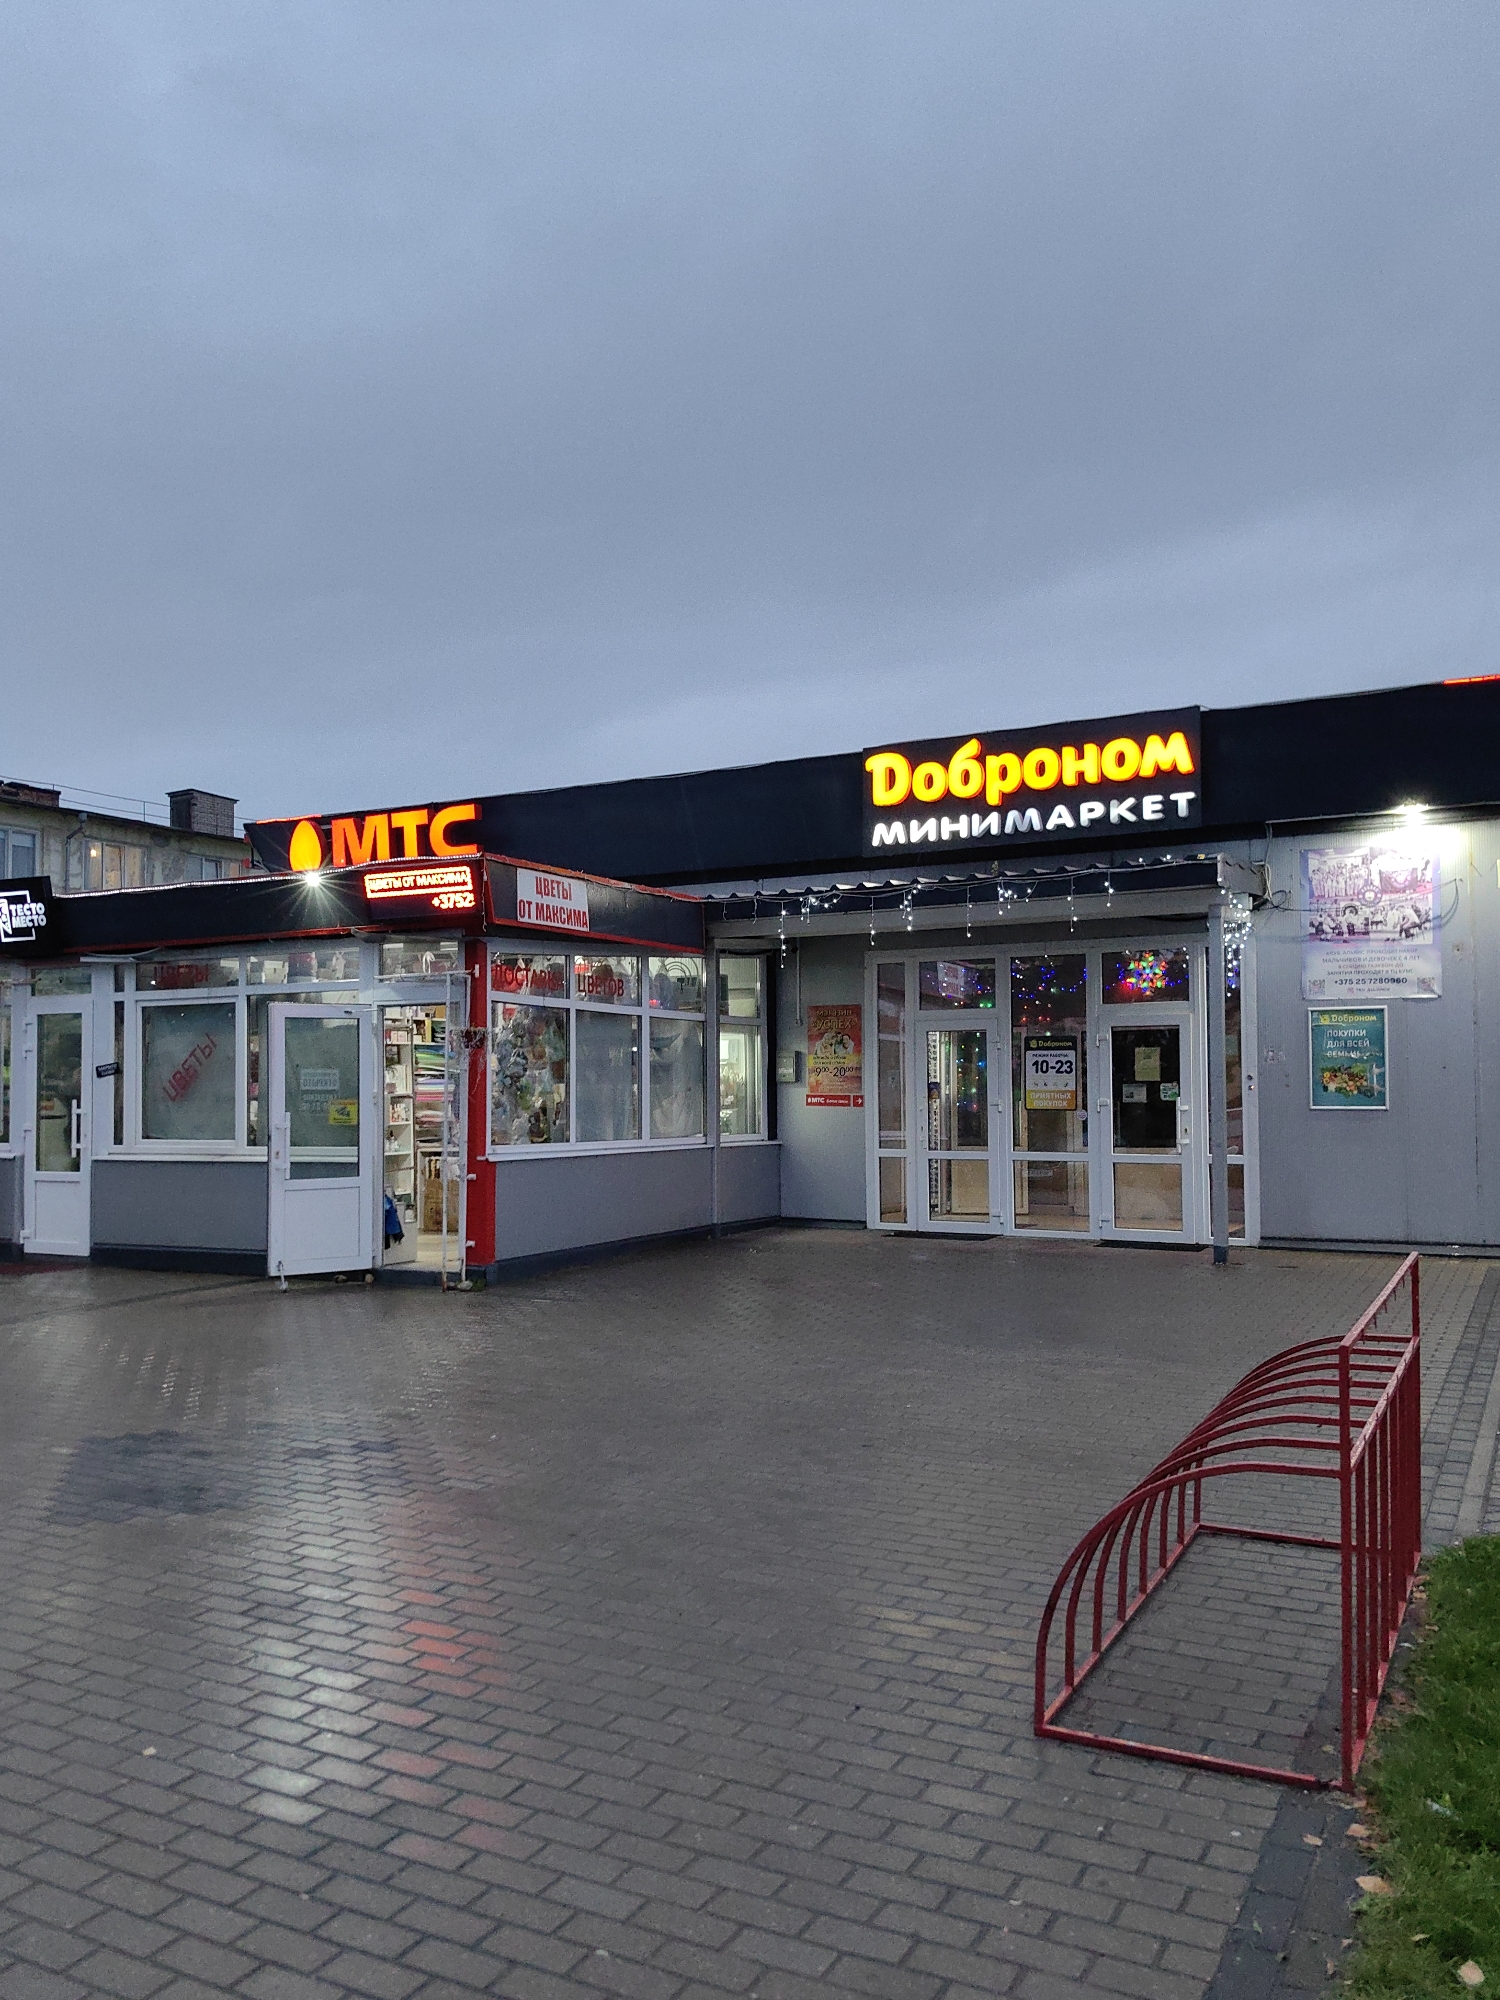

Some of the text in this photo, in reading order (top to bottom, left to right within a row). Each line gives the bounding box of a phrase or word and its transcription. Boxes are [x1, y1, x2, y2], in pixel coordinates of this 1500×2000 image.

[865, 732, 1195, 806] Доброном
[872, 792, 1196, 847] МИНИМАРКЕТ
[331, 804, 478, 867] МТС
[369, 872, 468, 891] ЦВЕТЫ ОТ МАКСИМА
[535, 876, 573, 901] ЦВЕТЫ
[9, 902, 46, 917] ТЕСТО
[518, 899, 588, 929] ОТ МАКСИМА
[11, 914, 47, 928] МЕСТО
[577, 972, 625, 997] ЦВЕТОВ
[1331, 1013, 1377, 1022] Доброном
[1327, 1029, 1366, 1037] ПОКУПКИ
[1038, 1040, 1073, 1048] Доброном
[1327, 1038, 1370, 1048] ДЛЯ ВСЕЙ
[1032, 1060, 1074, 1074] 10-23
[1030, 1092, 1072, 1100] ПРИЯТНЫХ
